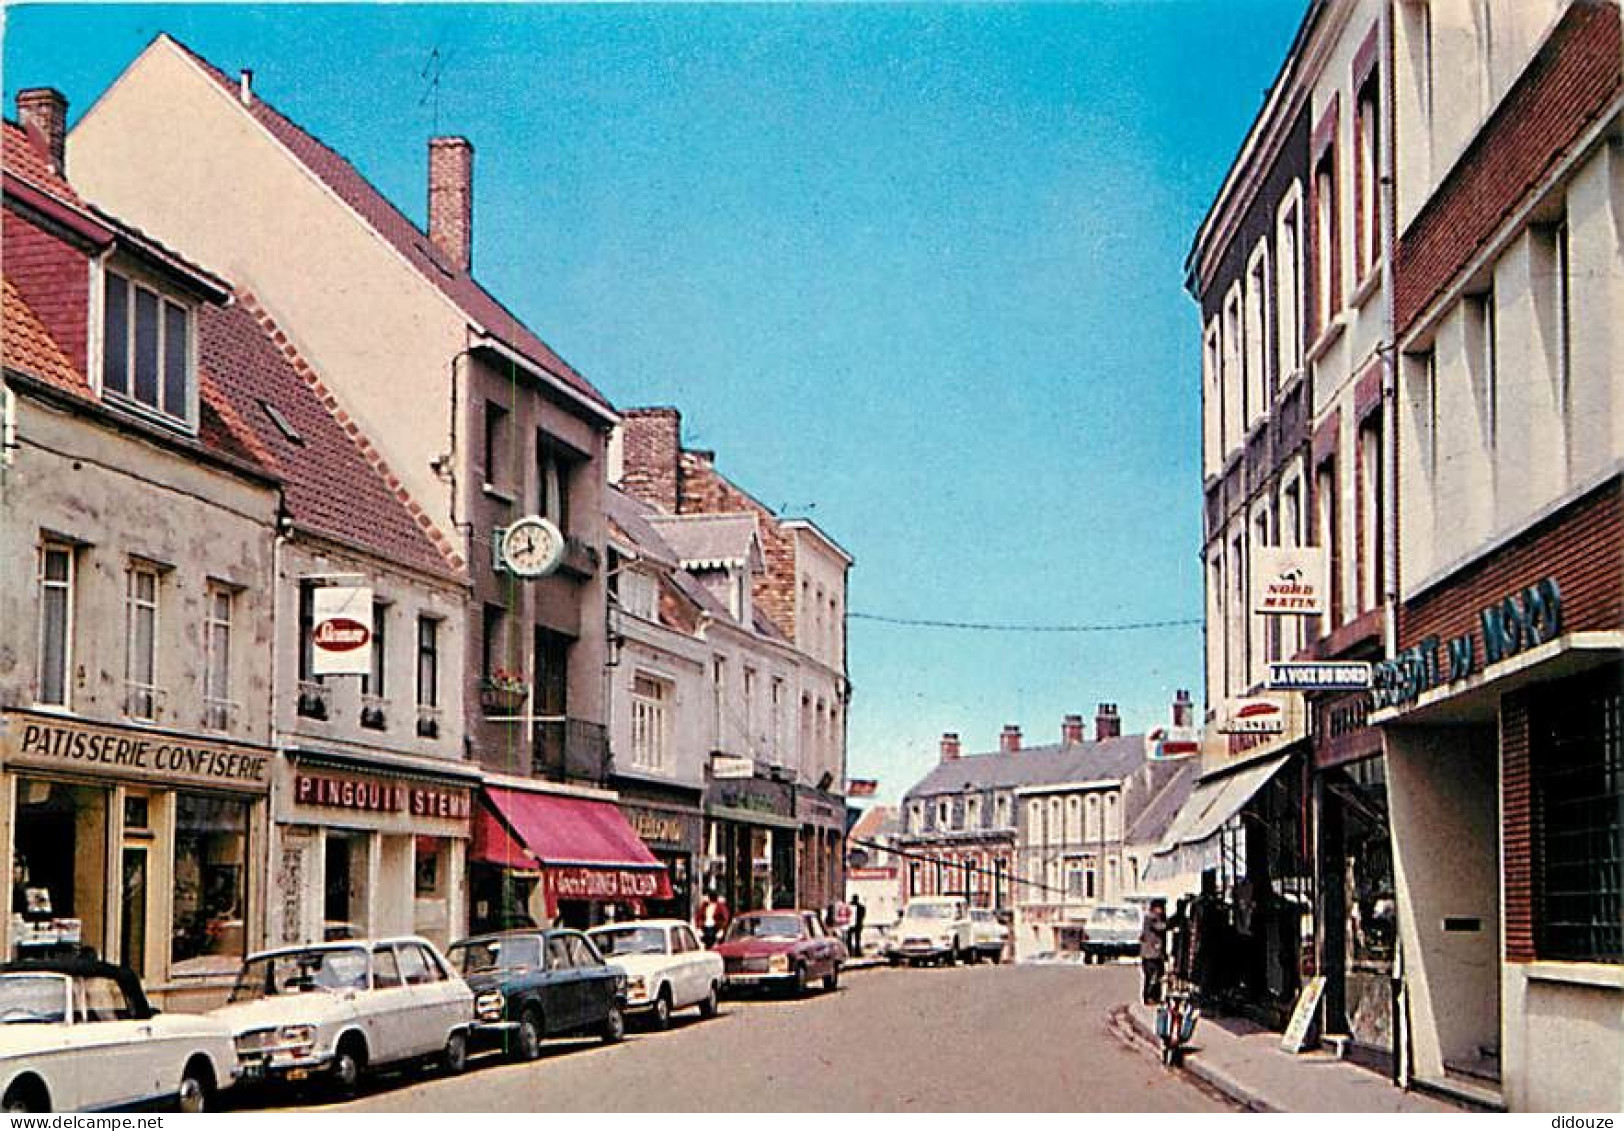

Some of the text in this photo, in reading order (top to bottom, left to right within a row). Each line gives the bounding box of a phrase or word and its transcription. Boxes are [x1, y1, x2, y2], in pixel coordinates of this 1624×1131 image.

[1267, 584, 1314, 595] NORD
[1264, 597, 1316, 608] MATIN
[1481, 576, 1562, 665] NORD
[1270, 667, 1287, 684] LA
[1287, 667, 1316, 684] VOIX
[1334, 667, 1366, 684] NORD
[22, 725, 269, 781] PATISSERIE CONFISERIE
[301, 777, 408, 811] PINGOUIN
